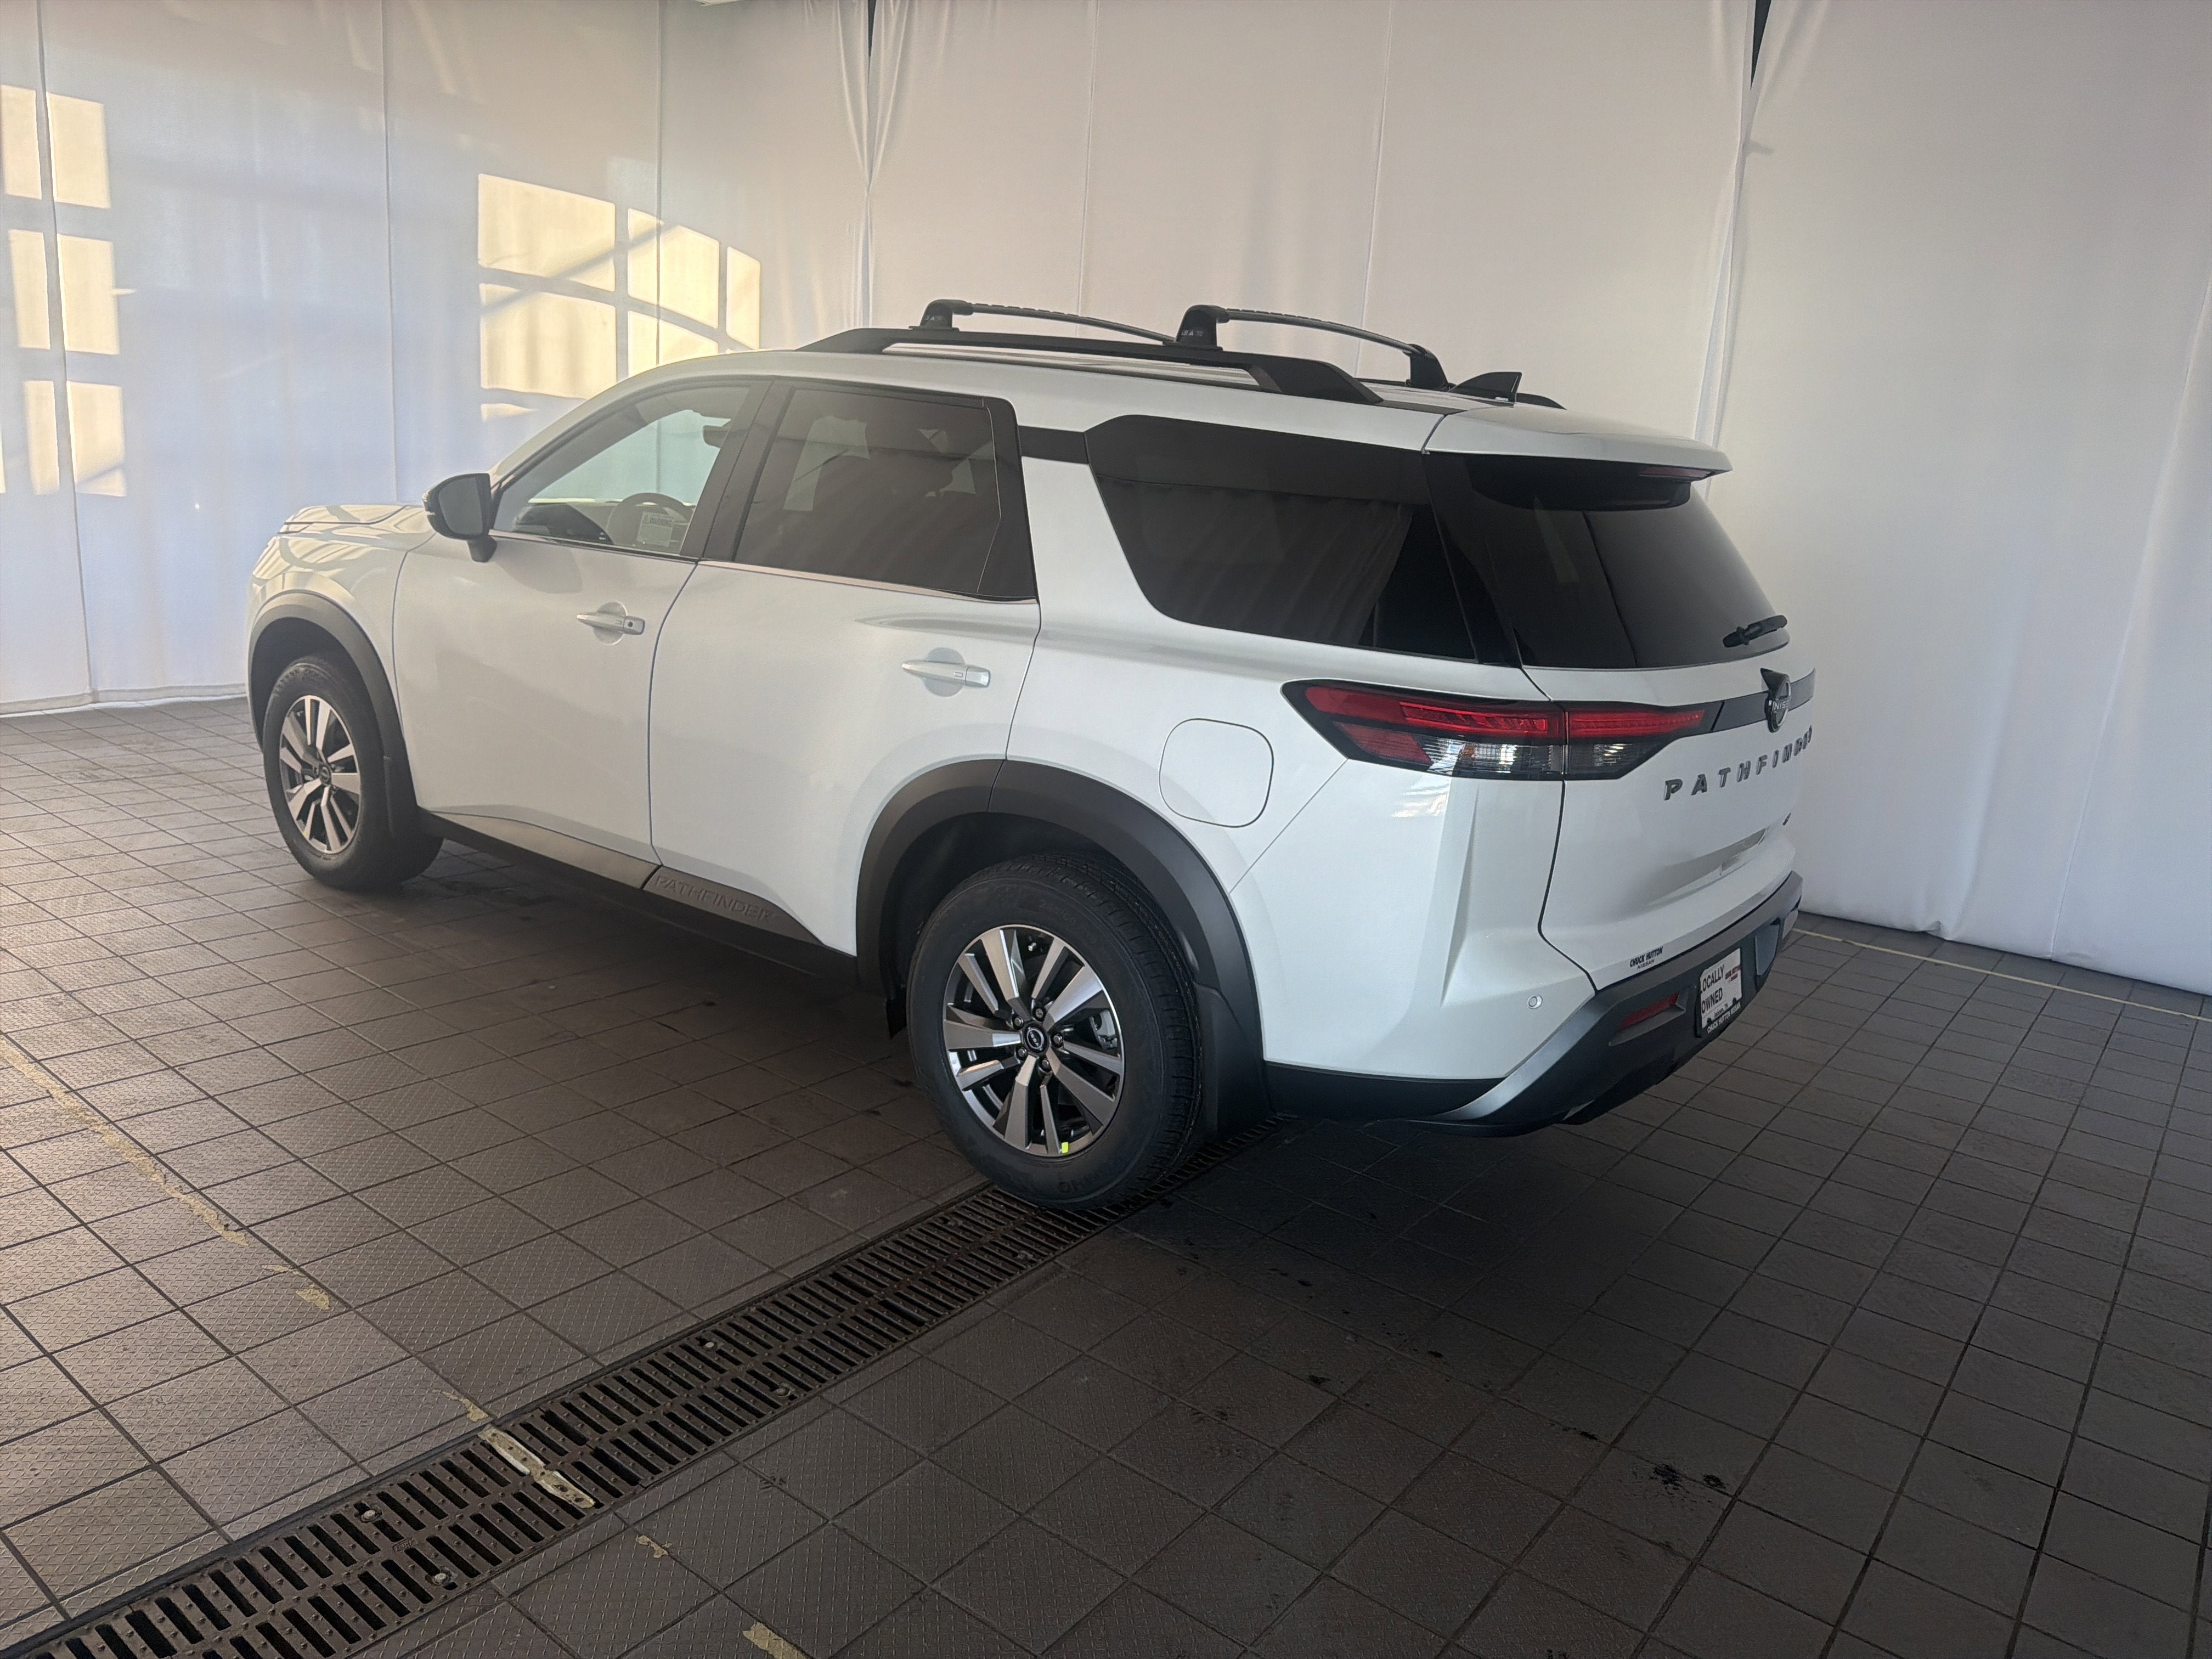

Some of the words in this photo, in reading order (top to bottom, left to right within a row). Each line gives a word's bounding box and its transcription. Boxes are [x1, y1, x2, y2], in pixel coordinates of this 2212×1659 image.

[654, 875, 776, 921] PATHFINDER
[1629, 954, 1645, 967] CHUCK
[1646, 946, 1663, 961] HUTTON
[1637, 958, 1655, 970] NISSAN
[1701, 988, 1723, 1014] OWNED
[1707, 1020, 1719, 1034] CHUCK
